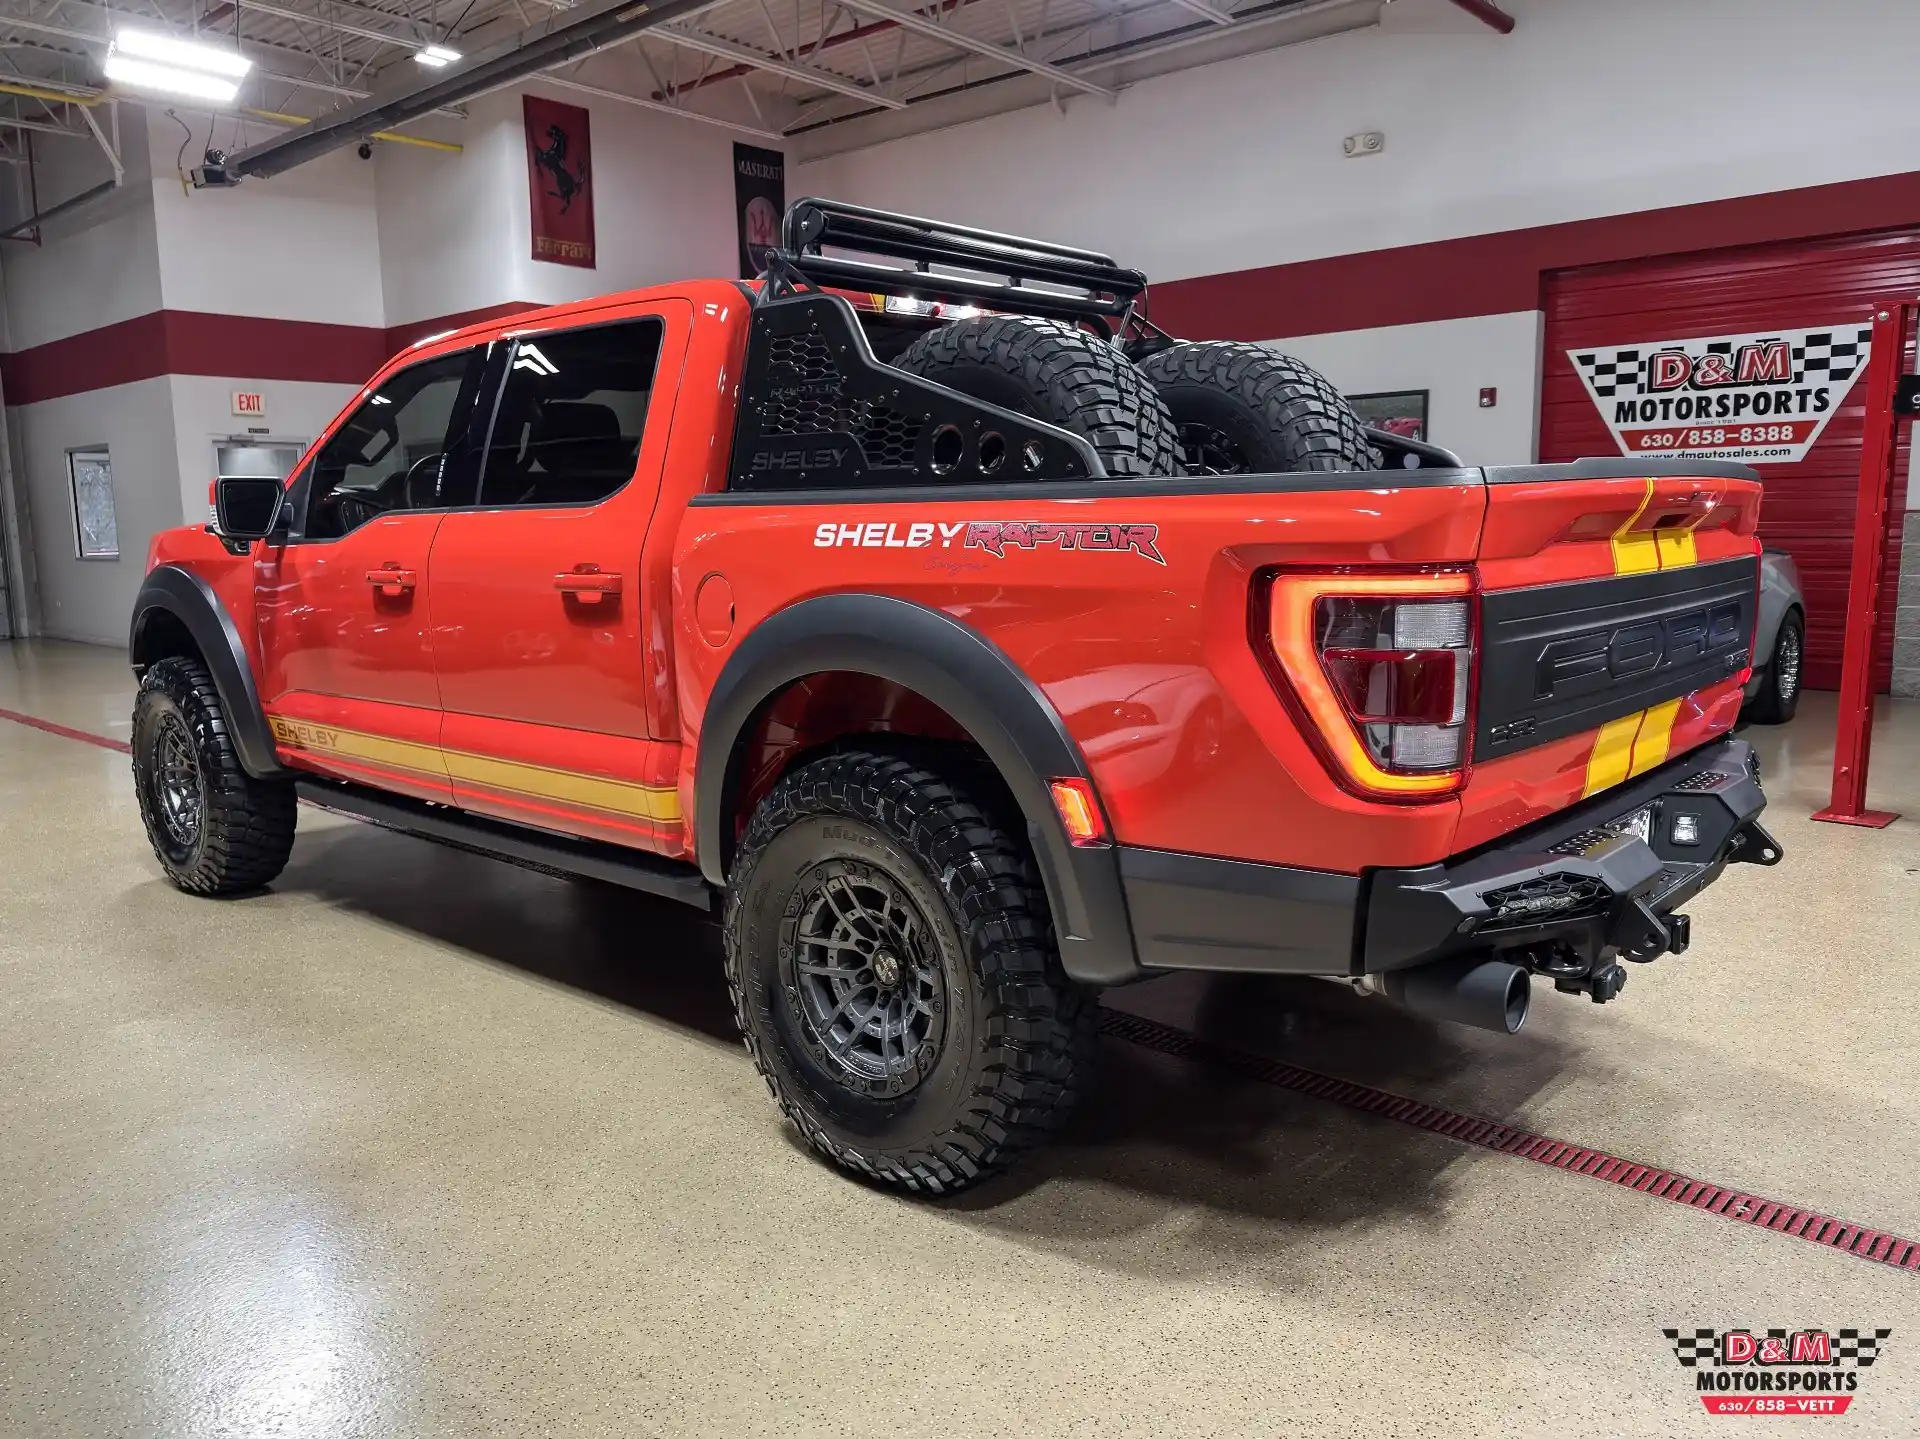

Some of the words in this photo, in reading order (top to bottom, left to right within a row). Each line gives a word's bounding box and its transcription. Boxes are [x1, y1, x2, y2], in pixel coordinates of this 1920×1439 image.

[1650, 341, 1792, 390] D&M
[238, 394, 260, 411] EXIT
[1615, 387, 1830, 423] MOTORSPORTS
[1640, 425, 1794, 448] 630/858-8388
[813, 523, 963, 548] SHELBY
[964, 522, 1168, 566] RAPTOR
[1533, 600, 1742, 701] FORD
[276, 722, 339, 747] SHELBY
